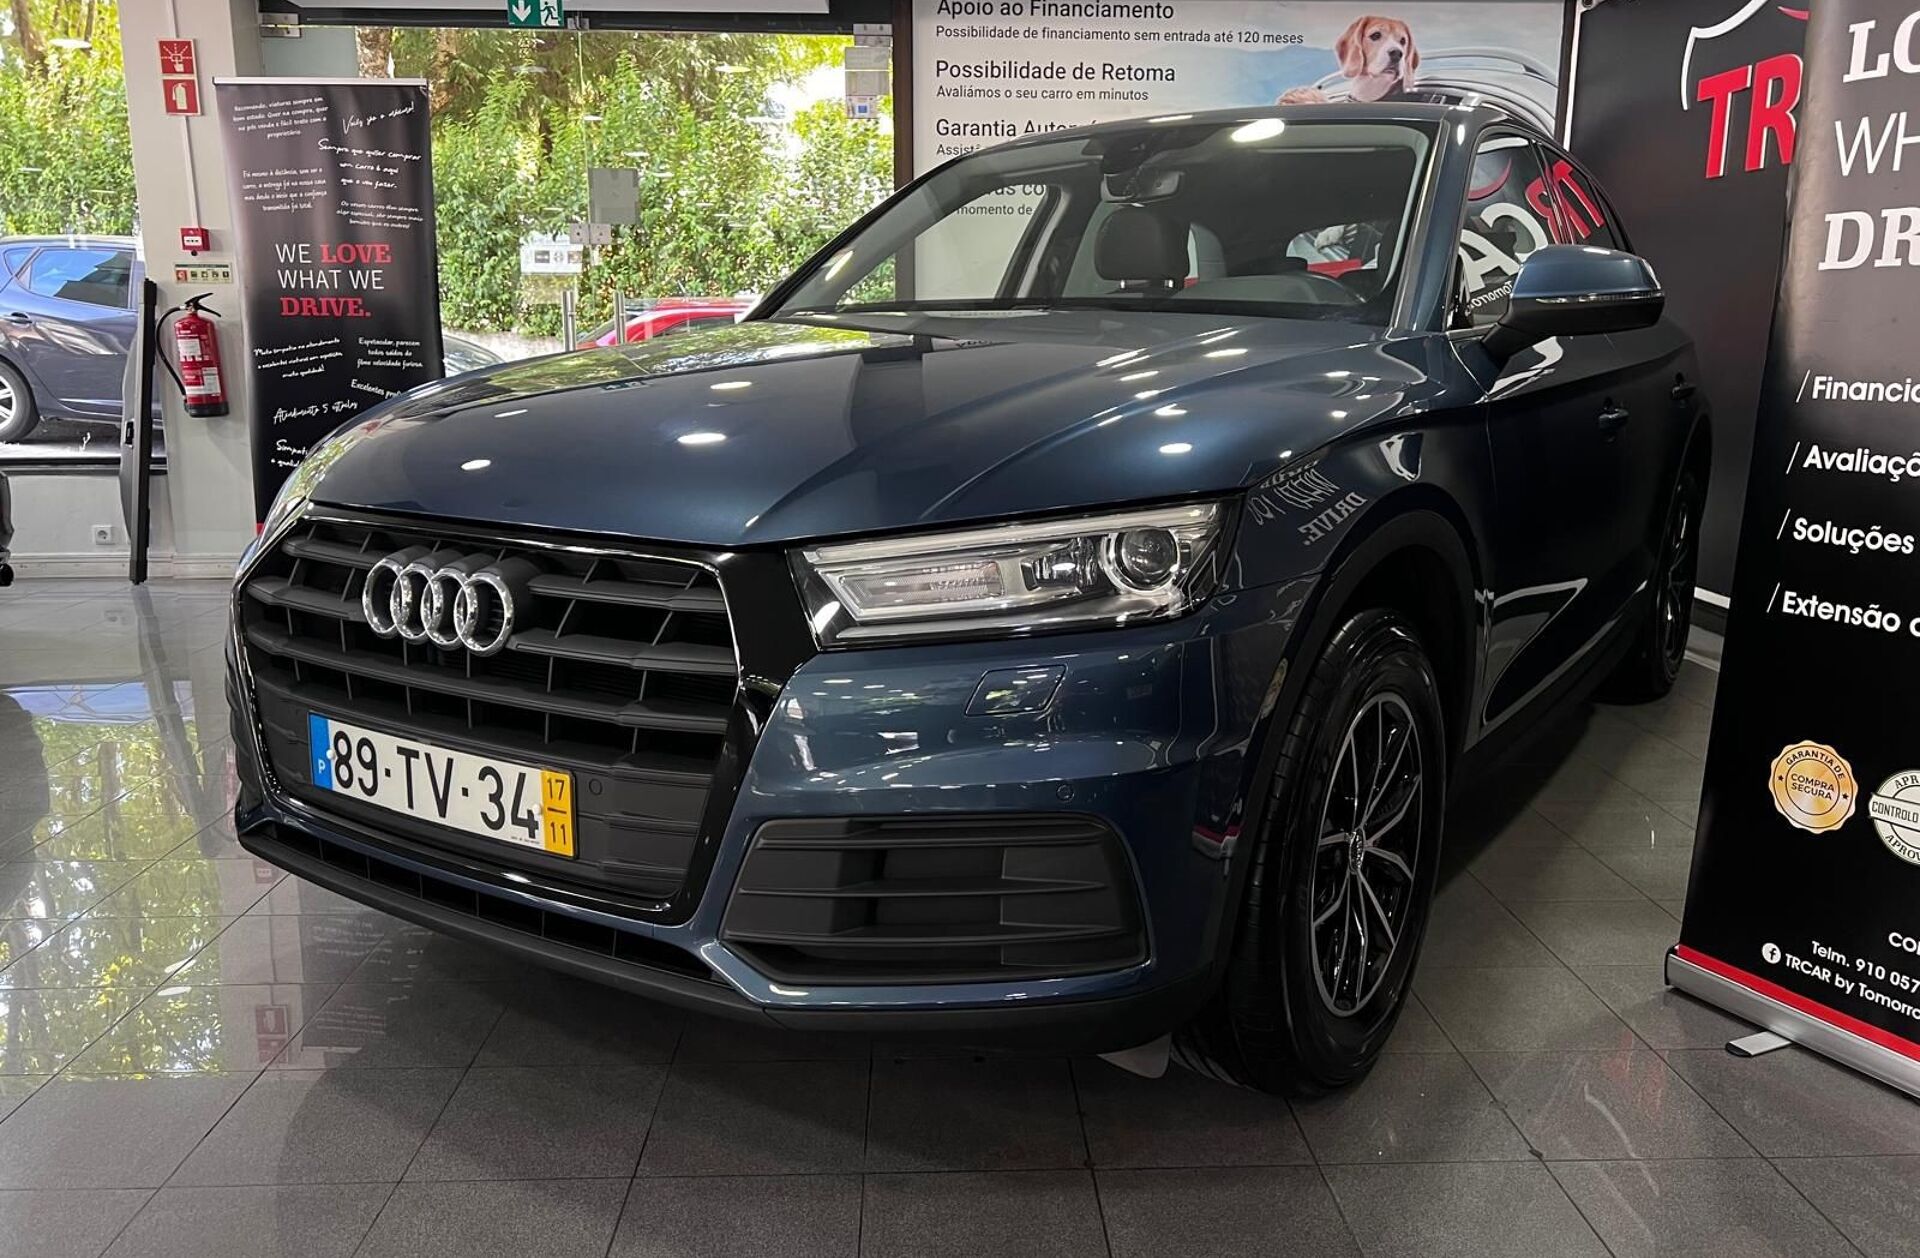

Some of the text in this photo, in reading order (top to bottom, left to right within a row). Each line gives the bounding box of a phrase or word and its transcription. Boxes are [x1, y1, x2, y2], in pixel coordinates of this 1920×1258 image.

[937, 0, 1174, 19] Apoio ao Financiamento
[936, 25, 1304, 44] Possibilidade de financiamento sem entrada até 120 meses
[936, 60, 1176, 82] Possibilidade de Retoma
[936, 84, 1149, 101] Avaliámos o seu carro em minutos
[1697, 53, 1804, 178] TR
[936, 119, 1017, 138] Garantia
[387, 151, 422, 162] comprar
[957, 204, 1033, 216] momento de
[275, 242, 392, 264] WE LOVE
[277, 269, 386, 290] WHAT WE
[280, 297, 372, 317] DRIVE.
[350, 378, 385, 396] Excelentes
[1793, 516, 1915, 555] Soluções
[1782, 590, 1901, 633] Extensão
[318, 759, 326, 774] P
[1786, 749, 1845, 780] GARANTIA DE
[546, 778, 566, 802] 17
[1791, 772, 1835, 792] COMPRA
[1791, 782, 1832, 800] SEGURA
[1871, 801, 1919, 823] CONTROLO
[549, 821, 568, 846] 11
[1888, 932, 1920, 956] CO
[1785, 953, 1831, 983] TRCAR
[1835, 974, 1855, 994] by
[1811, 940, 1920, 994] Telm. 910 057
